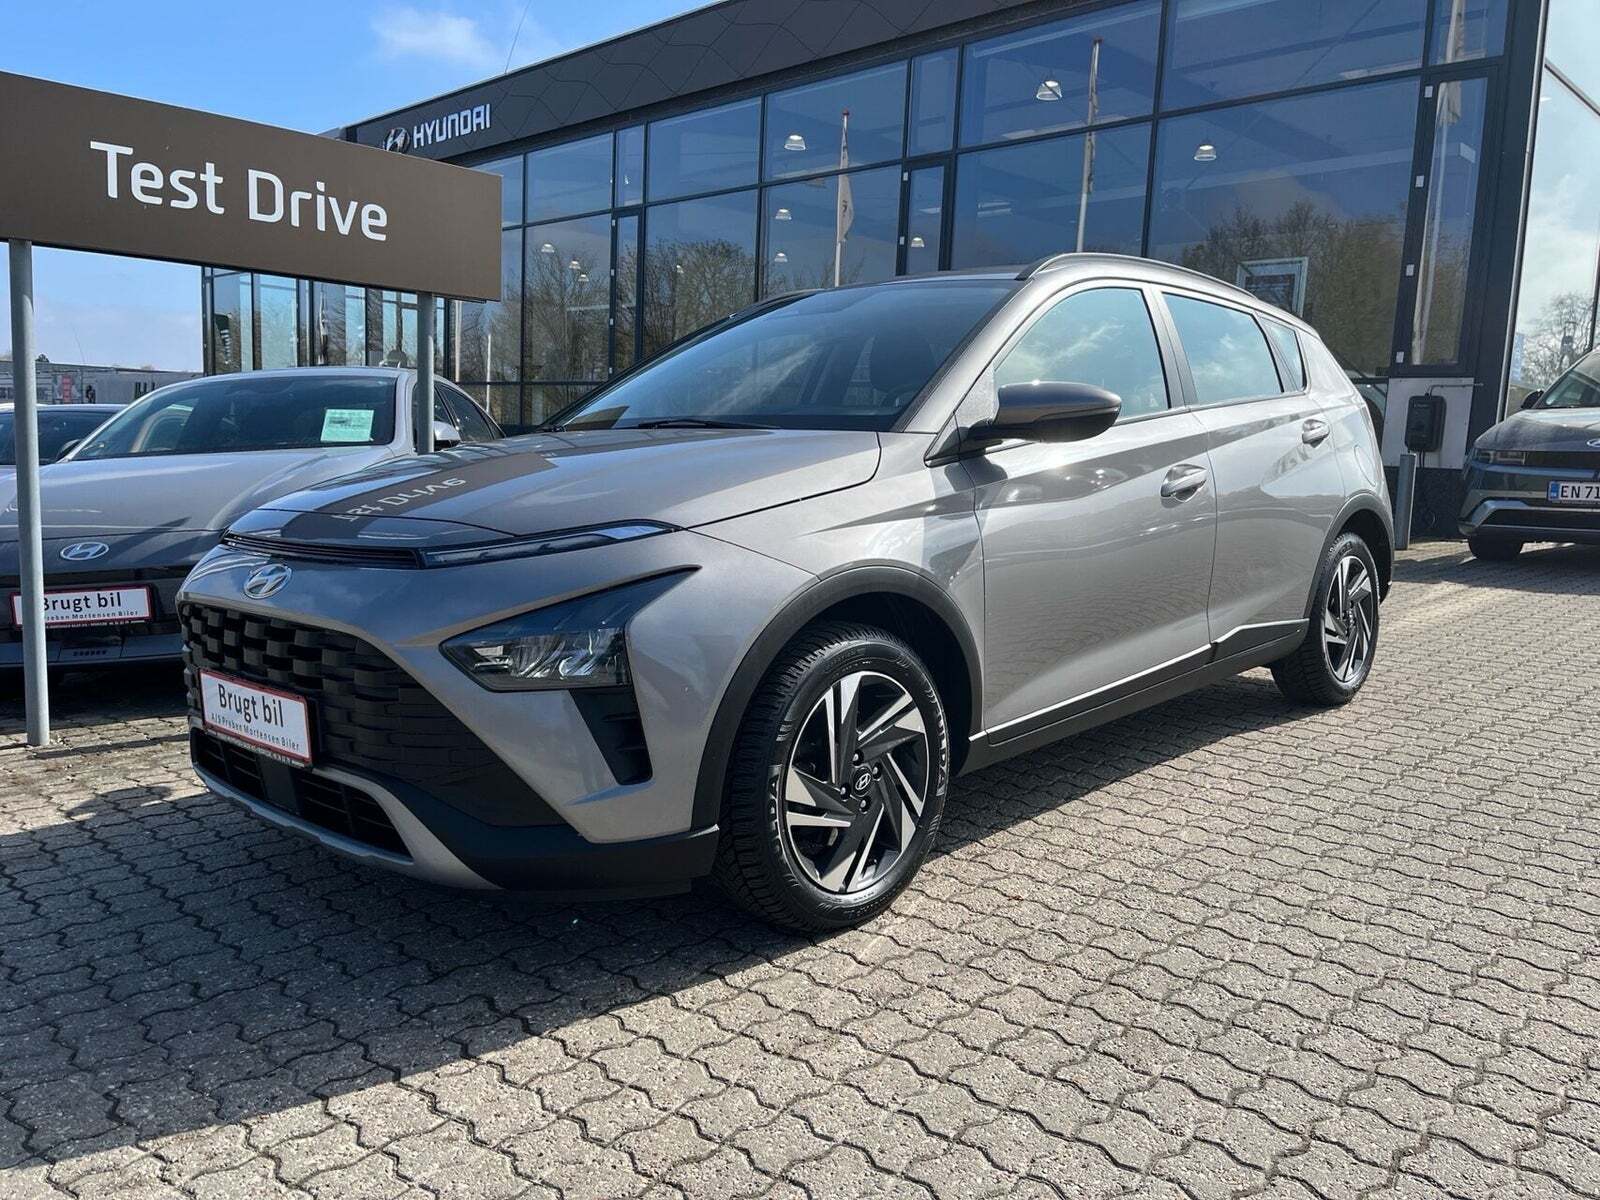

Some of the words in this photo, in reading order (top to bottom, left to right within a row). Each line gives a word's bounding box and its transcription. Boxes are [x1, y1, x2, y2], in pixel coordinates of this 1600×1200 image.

[412, 103, 492, 149] HYUNDAI
[90, 141, 225, 215] Test
[247, 168, 387, 242] Drive
[1560, 485, 1580, 499] EN
[97, 591, 122, 608] bil
[217, 683, 259, 723] Brugt
[262, 695, 284, 728] bil
[222, 715, 242, 731] Preben
[243, 723, 281, 744] Mortensen
[281, 736, 300, 752] Biler
